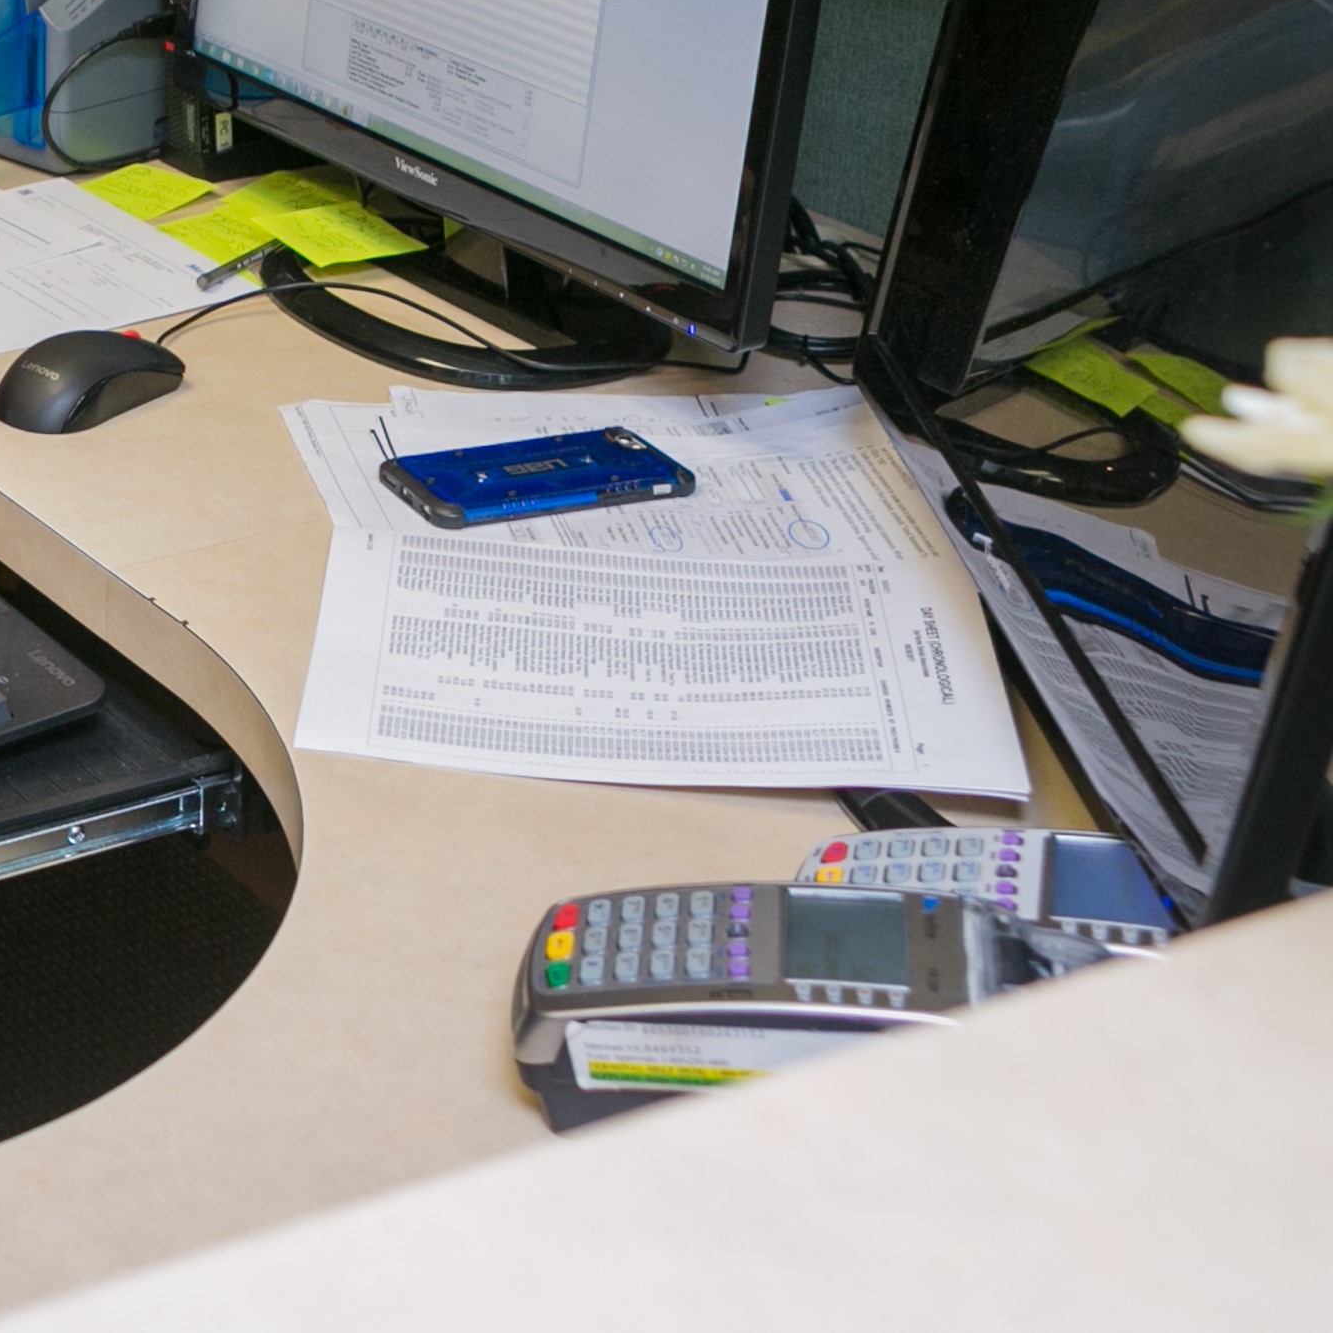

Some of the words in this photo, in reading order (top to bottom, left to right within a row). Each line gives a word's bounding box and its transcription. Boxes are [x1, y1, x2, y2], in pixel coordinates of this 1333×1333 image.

[220, 120, 229, 136] PC
[395, 156, 438, 186] ViewSonic
[21, 359, 60, 380] Lenovo
[503, 458, 568, 476] UAG
[920, 607, 933, 618] DAY
[924, 620, 939, 639] SHEET
[27, 649, 75, 686] Lenovo
[928, 640, 955, 705] (CHRONOLOGICAL)
